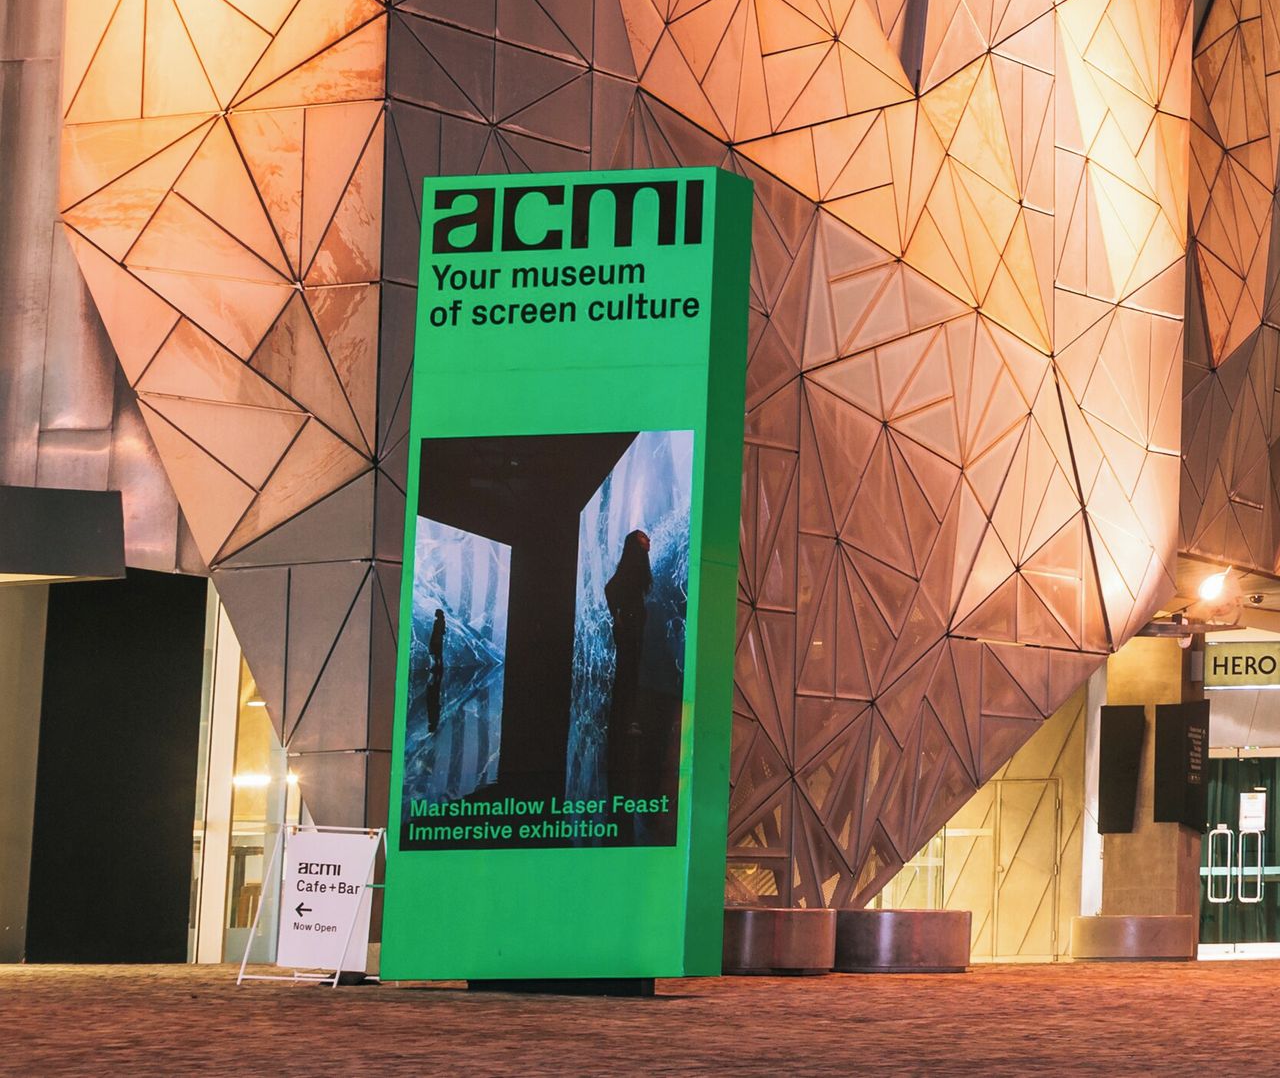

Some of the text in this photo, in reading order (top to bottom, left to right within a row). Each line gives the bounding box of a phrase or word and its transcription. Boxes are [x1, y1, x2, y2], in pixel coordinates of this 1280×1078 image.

[432, 180, 704, 254] acmi
[432, 262, 646, 291] Your museum
[429, 293, 700, 327] of screen culture
[1213, 656, 1276, 675] HERO
[410, 794, 670, 818] Marshmallow Laser Feast
[408, 820, 619, 841] Immersive exhibition
[298, 862, 341, 876] acmi
[293, 922, 337, 933] Now Open
